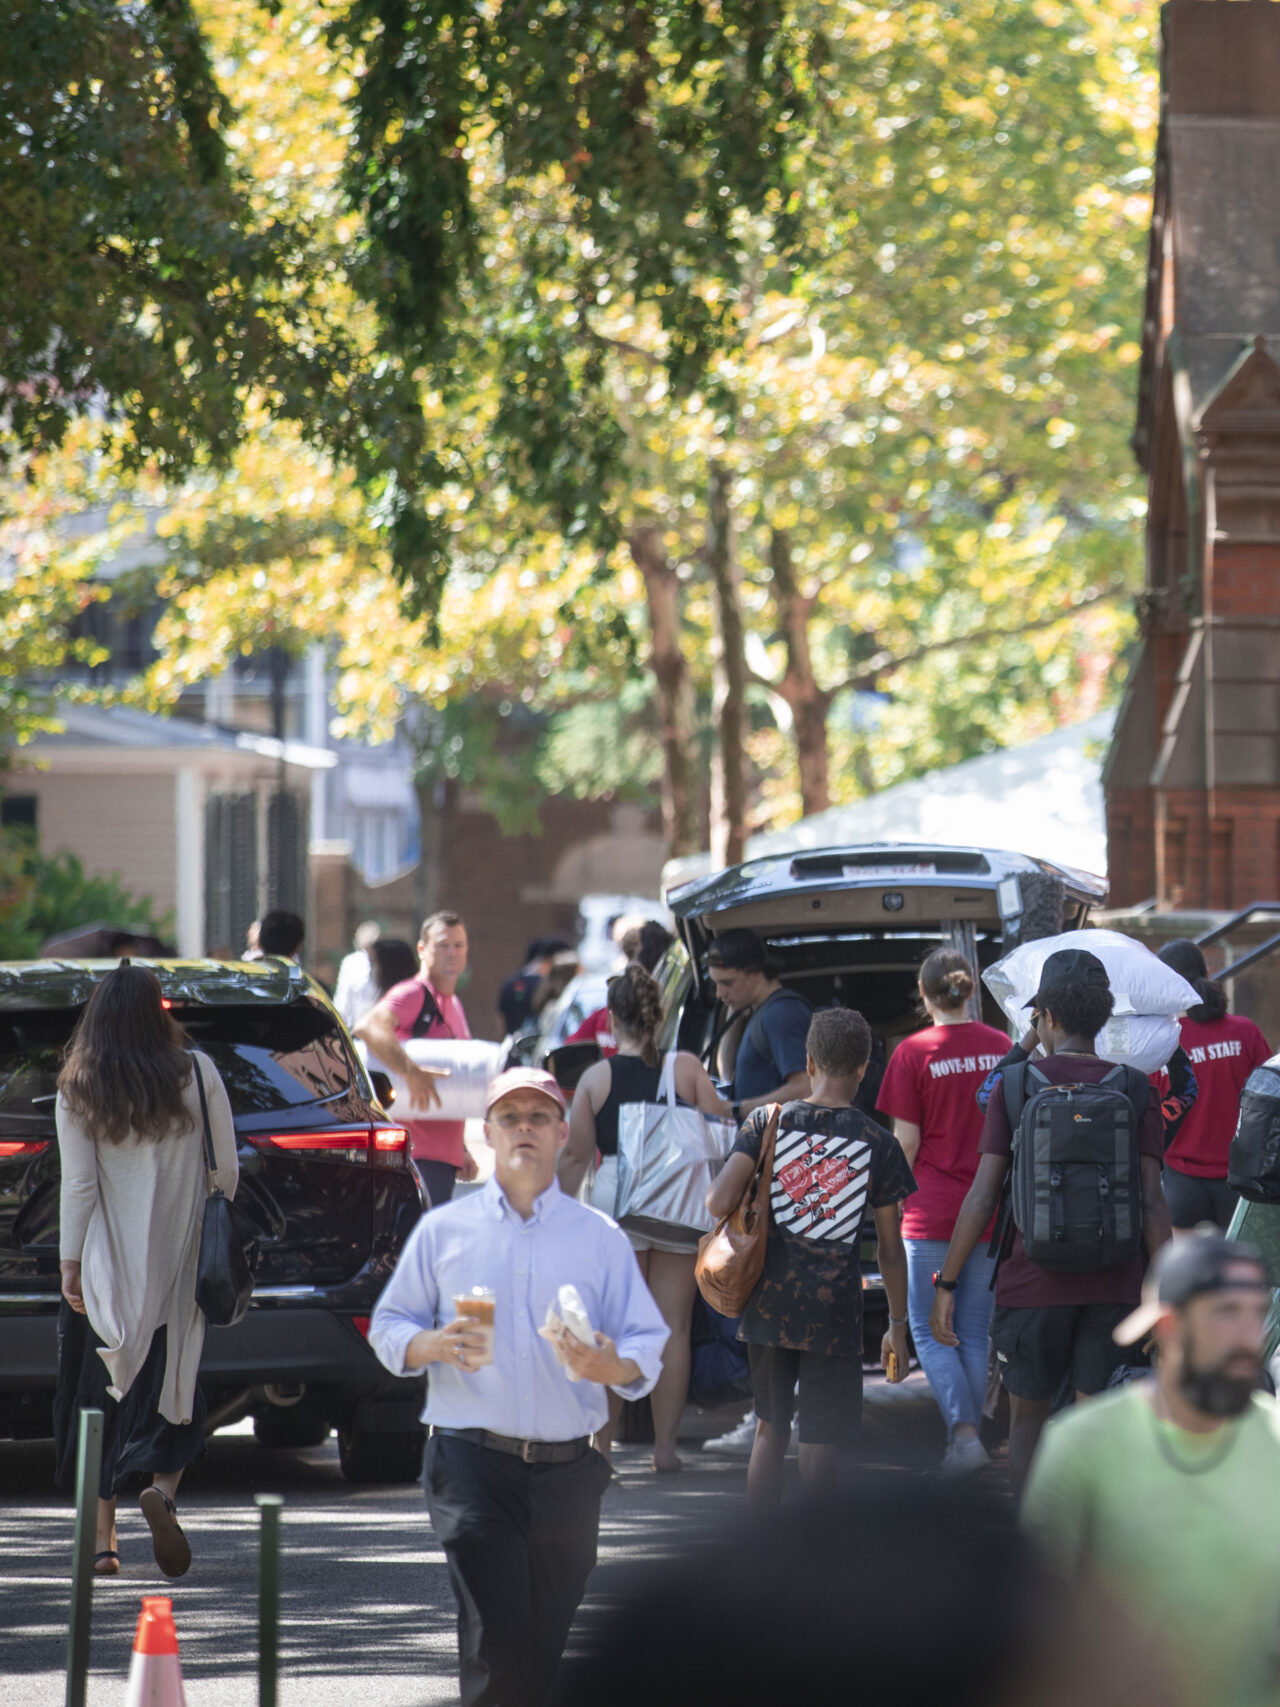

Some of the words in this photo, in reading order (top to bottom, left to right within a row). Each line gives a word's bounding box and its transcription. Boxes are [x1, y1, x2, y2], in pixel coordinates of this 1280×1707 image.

[1207, 1041, 1241, 1060] STAFF
[929, 1056, 976, 1078] MOVE-IN
[978, 1054, 1005, 1071] STA
